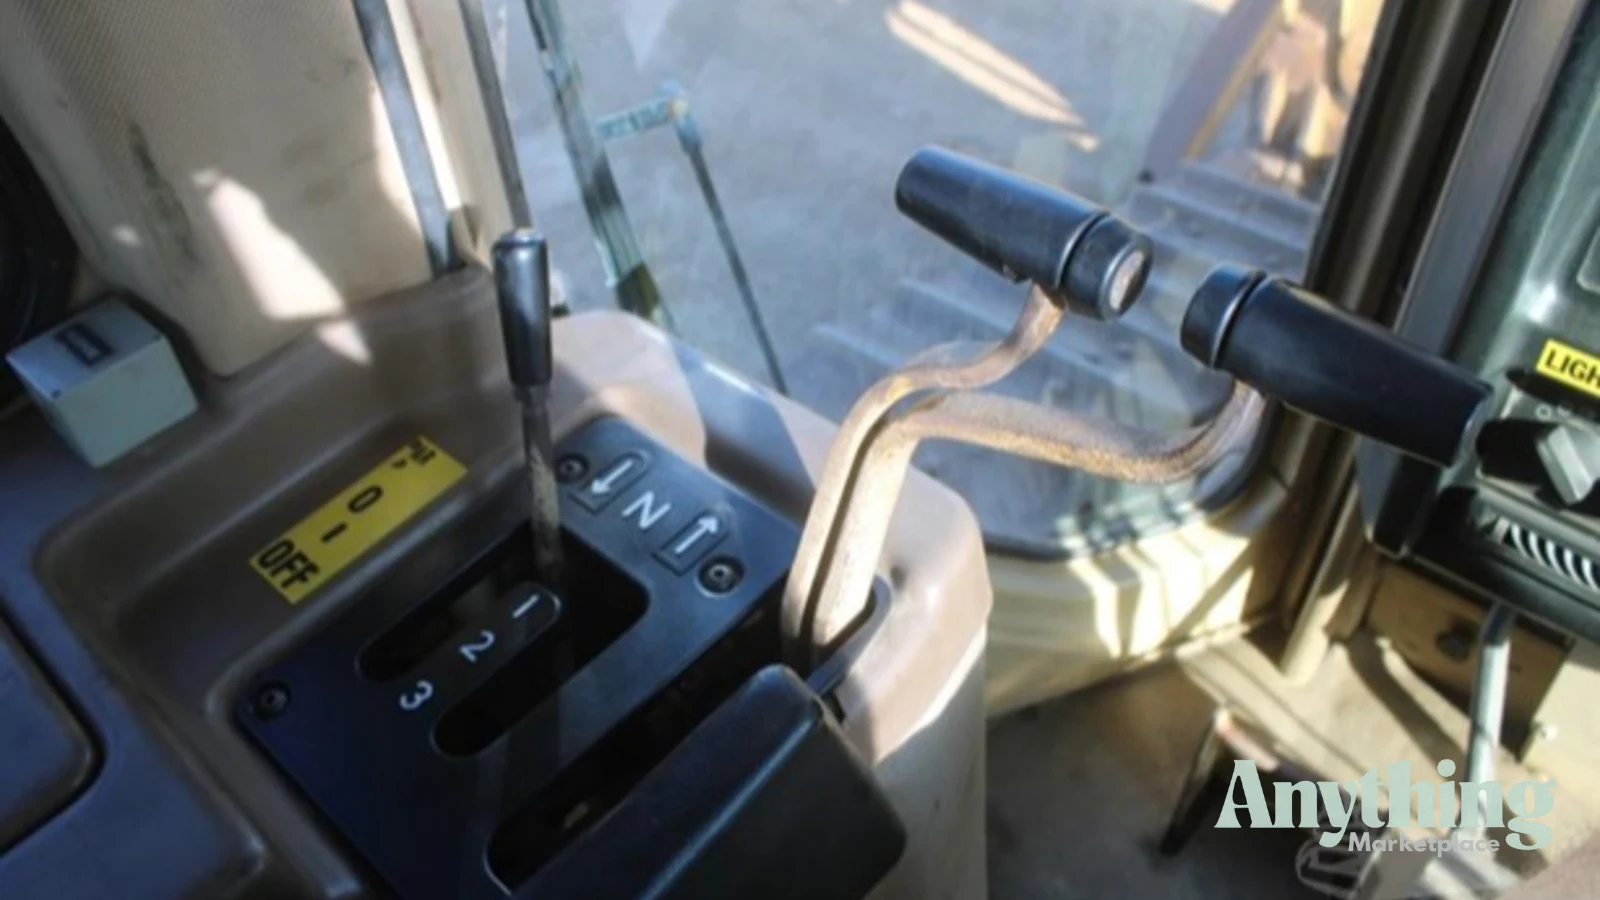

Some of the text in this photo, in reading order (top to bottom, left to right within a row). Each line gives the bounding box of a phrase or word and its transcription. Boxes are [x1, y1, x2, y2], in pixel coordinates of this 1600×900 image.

[622, 491, 670, 529] N
[256, 539, 321, 589] OFF
[459, 630, 495, 663] 2
[399, 680, 433, 711] 3
